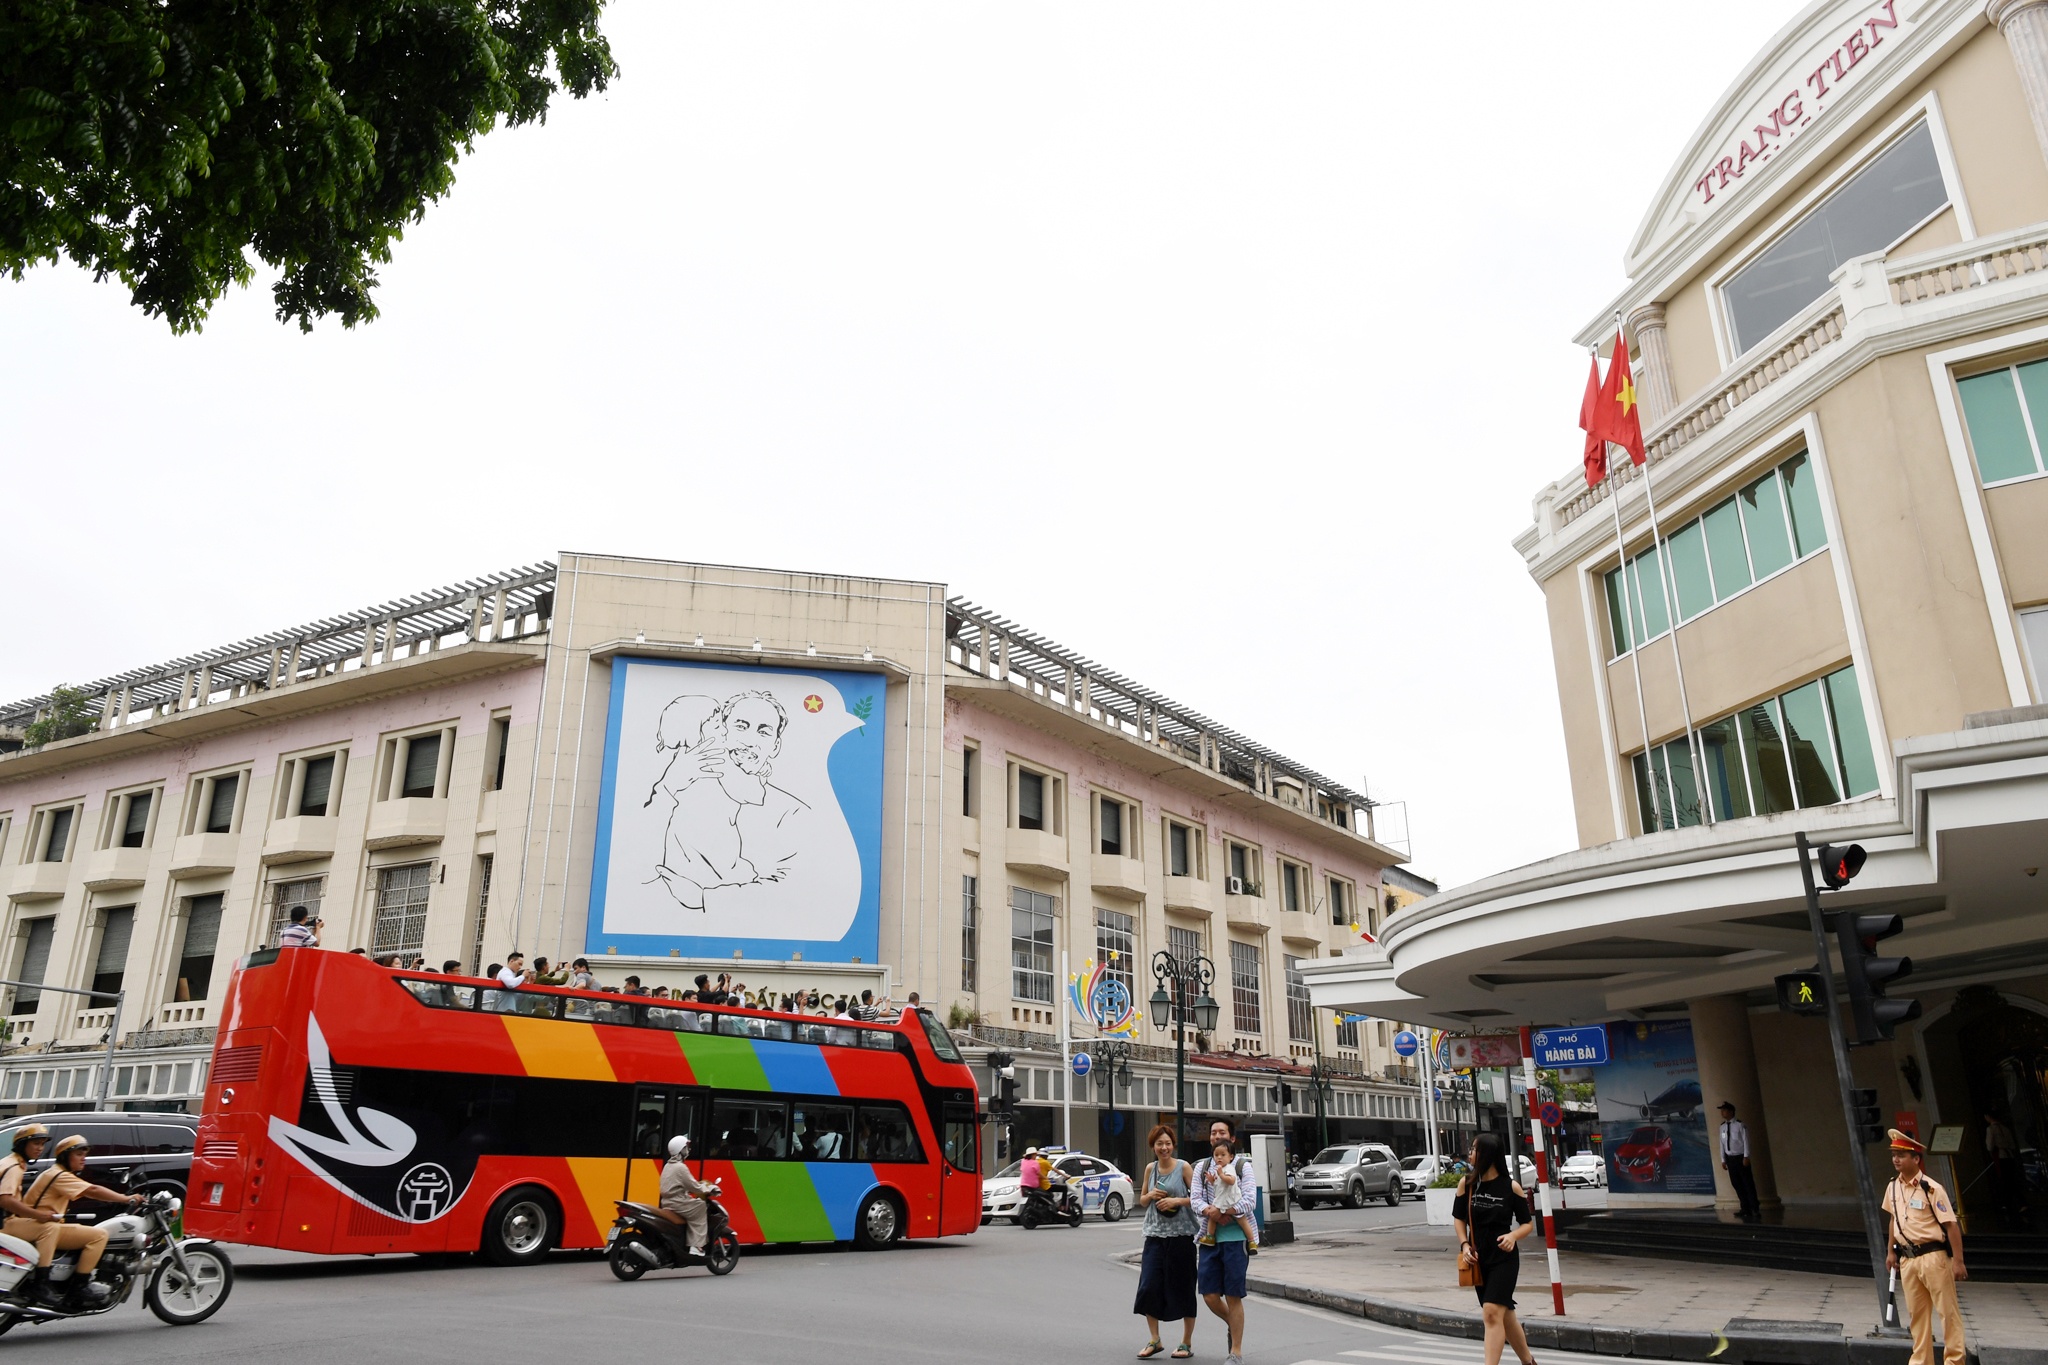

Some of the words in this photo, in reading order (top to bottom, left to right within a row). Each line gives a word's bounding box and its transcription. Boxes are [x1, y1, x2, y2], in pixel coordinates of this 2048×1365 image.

[1696, 89, 1804, 204] TRANG
[1806, 0, 1898, 100] TIEN
[782, 988, 835, 1009] NỚC
[1558, 1033, 1578, 1043] PHỐ
[1545, 1047, 1575, 1062] HÀNG
[1577, 1045, 1596, 1060] BÀI
